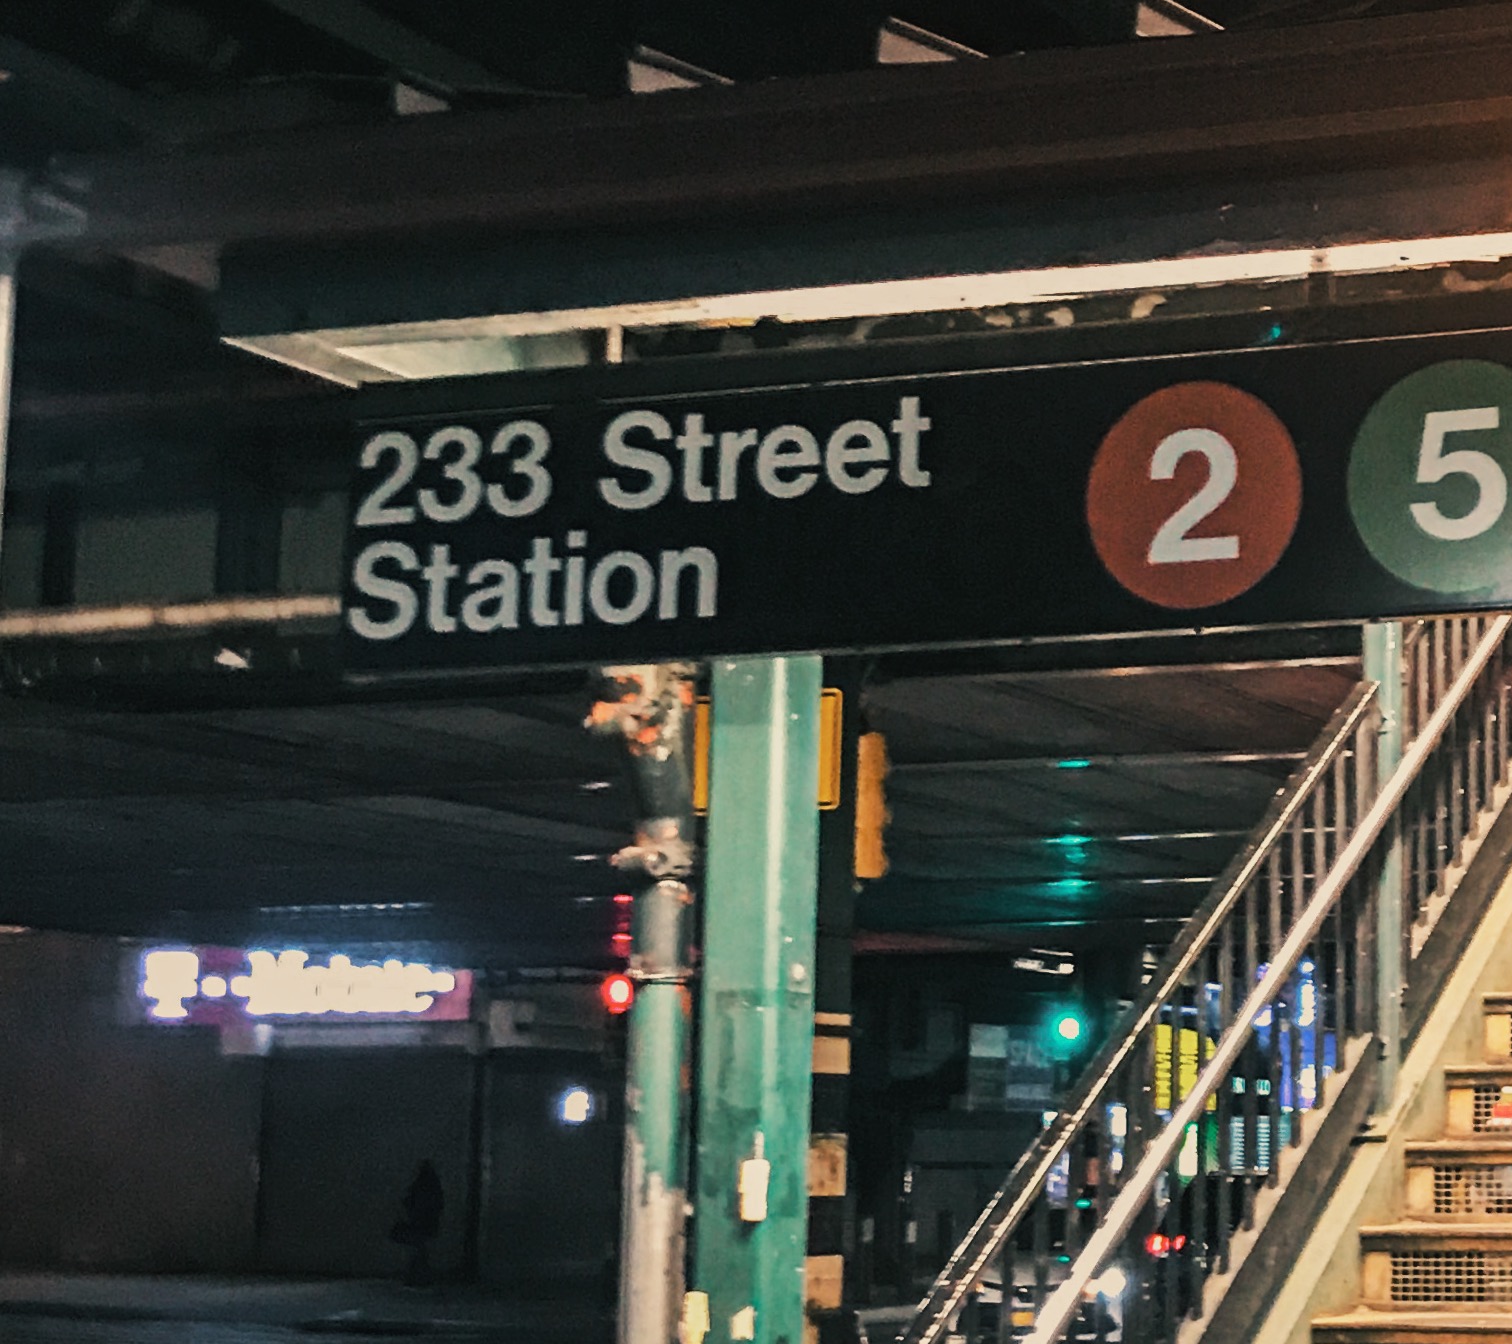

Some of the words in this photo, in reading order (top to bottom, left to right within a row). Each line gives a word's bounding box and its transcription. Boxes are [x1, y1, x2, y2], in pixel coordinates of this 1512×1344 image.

[354, 419, 553, 526] 233
[599, 396, 932, 511] Street
[1147, 428, 1240, 565] 2
[1409, 406, 1508, 541] 5
[348, 530, 719, 640] Station
